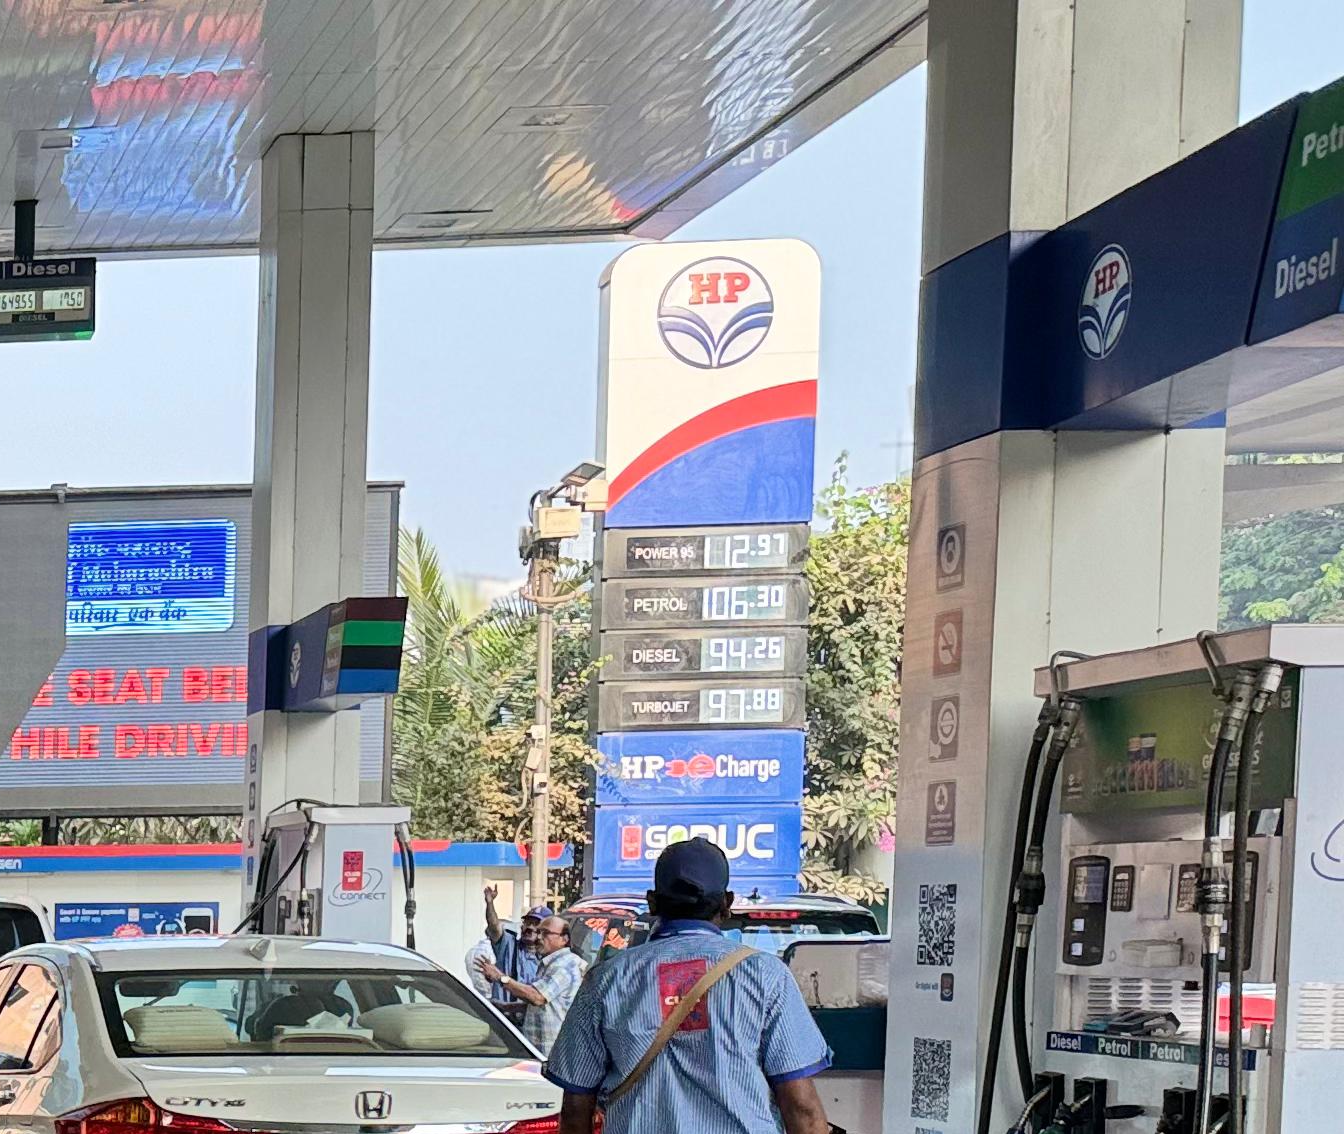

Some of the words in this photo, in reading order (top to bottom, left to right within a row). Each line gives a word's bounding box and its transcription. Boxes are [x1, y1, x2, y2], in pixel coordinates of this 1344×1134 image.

[12, 260, 76, 277] Diesel
[1092, 260, 1120, 299] HP
[1274, 236, 1339, 300] Diesel
[688, 272, 751, 304] HP
[634, 547, 678, 560] POWER
[680, 546, 694, 559] 95
[703, 533, 786, 568] 112.97
[633, 598, 688, 612] PETROL
[702, 584, 784, 620] 106.30
[632, 649, 681, 664] DIESEL
[709, 636, 781, 671] 94.26
[67, 667, 170, 706] SEAT
[631, 700, 690, 714] TURBOJET
[708, 688, 780, 723] 97.88
[621, 755, 665, 779] HP
[1050, 1033, 1082, 1051] Diesel
[1098, 1038, 1131, 1057] Petrol
[1149, 1043, 1185, 1061] Petrol
